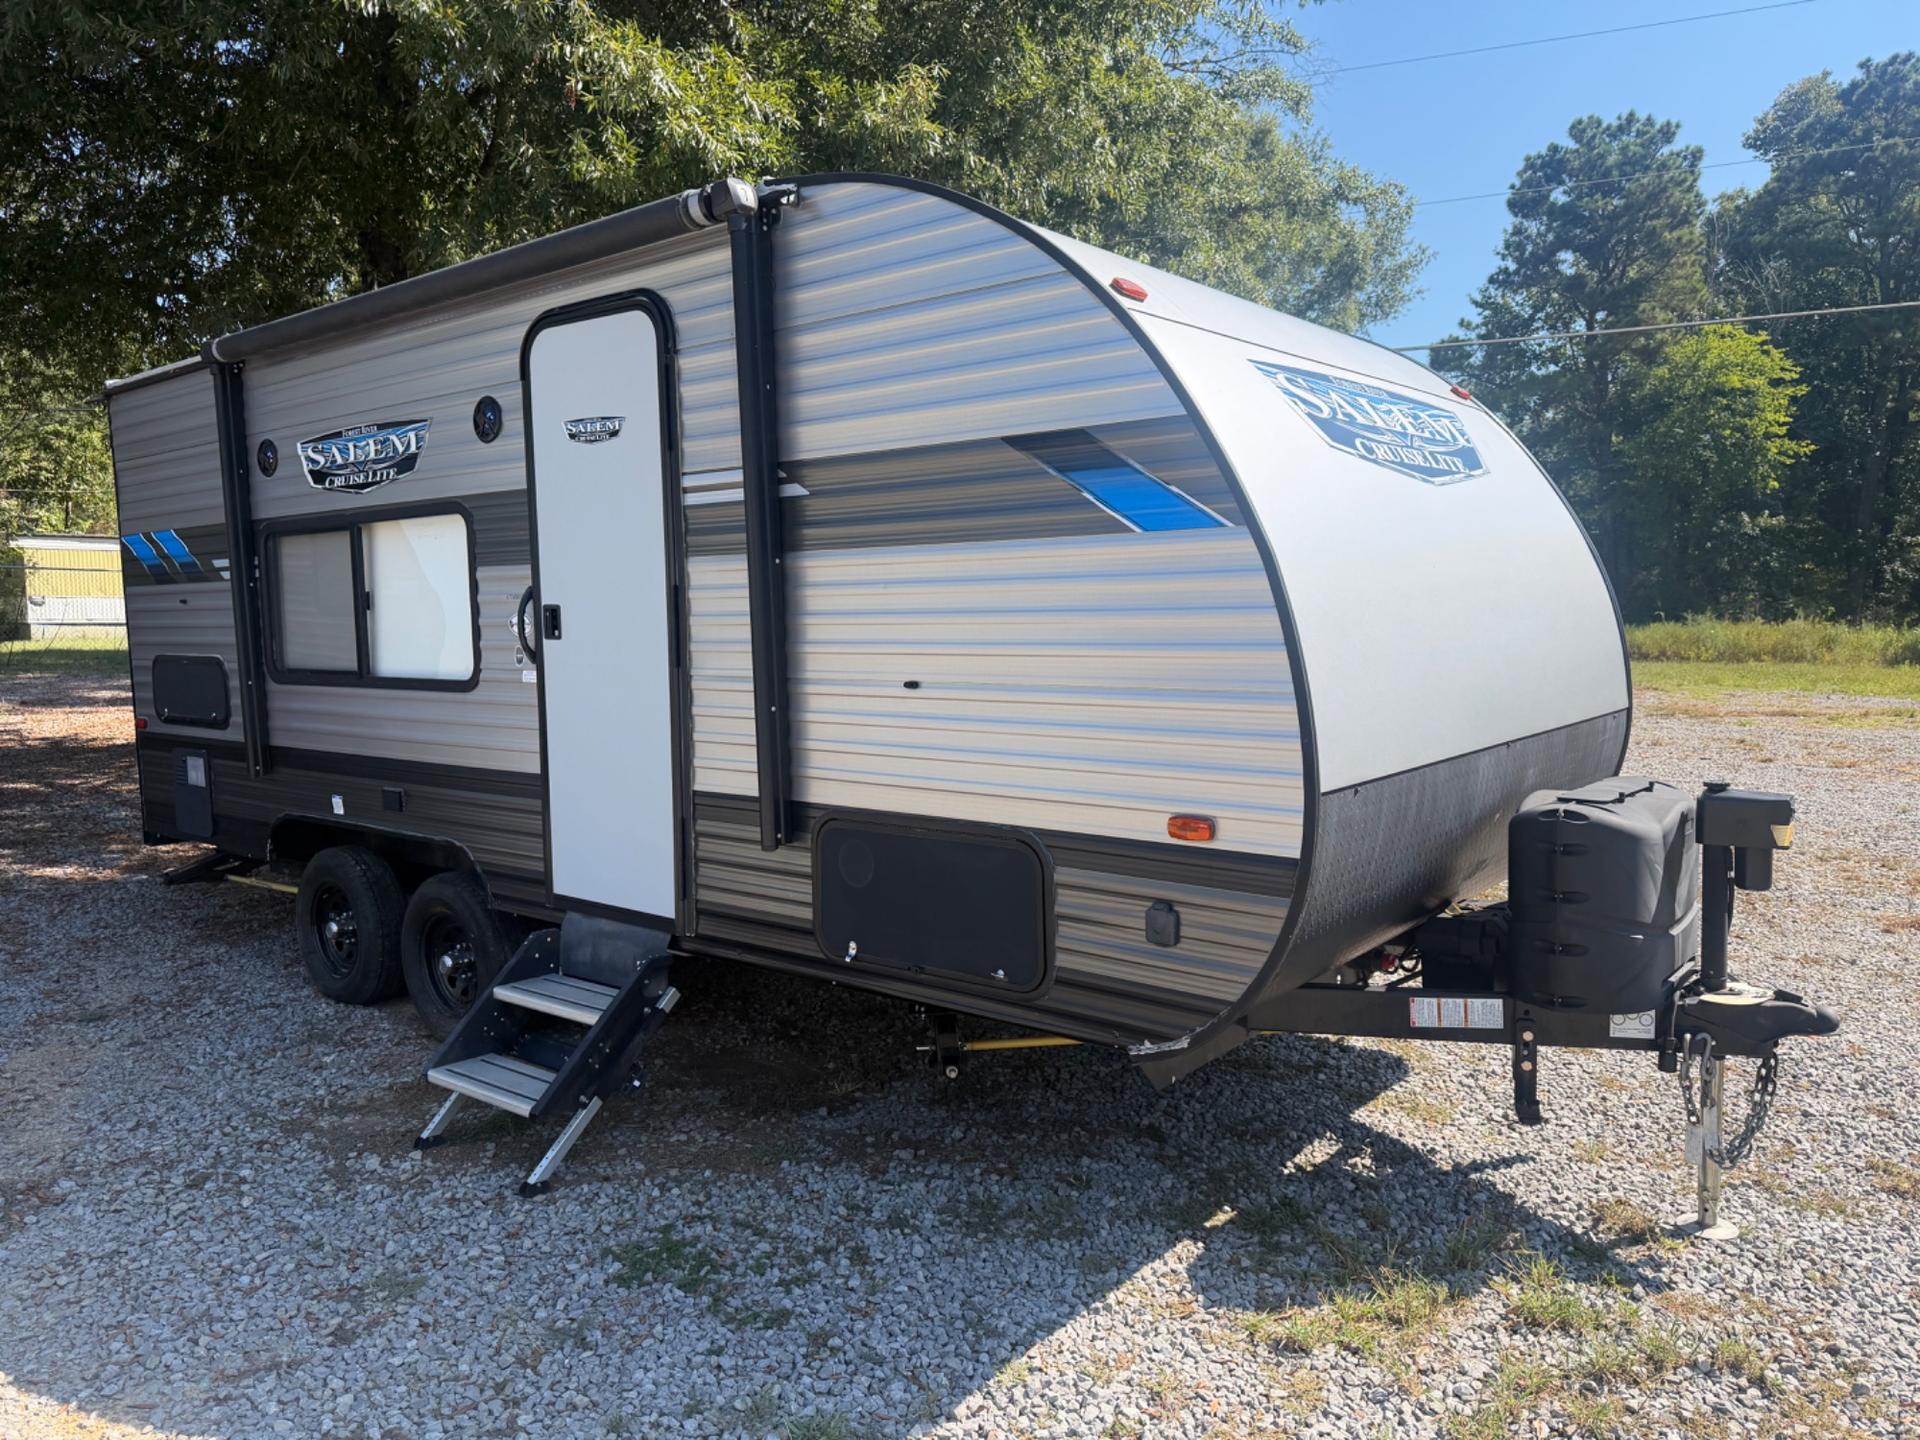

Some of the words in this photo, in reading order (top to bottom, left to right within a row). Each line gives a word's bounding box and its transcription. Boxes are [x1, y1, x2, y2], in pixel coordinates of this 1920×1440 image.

[566, 420, 620, 433] SALEM
[1275, 373, 1472, 447] SALEM
[306, 430, 419, 470] SALEM
